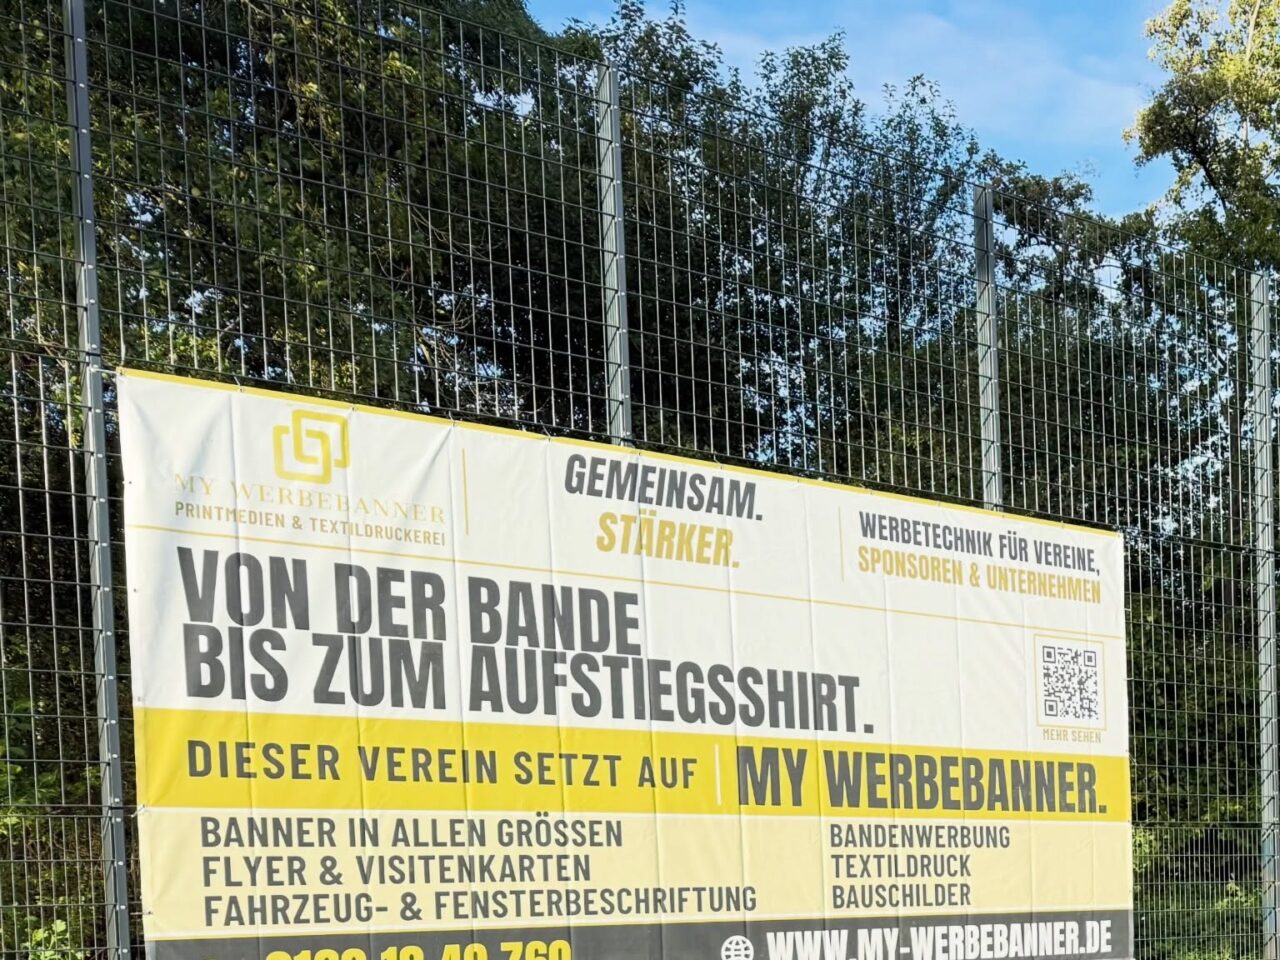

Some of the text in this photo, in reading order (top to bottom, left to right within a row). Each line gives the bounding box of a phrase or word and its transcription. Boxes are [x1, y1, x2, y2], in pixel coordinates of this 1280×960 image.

[175, 473, 446, 524] MY WERBEBANNER
[564, 452, 764, 522] GEMEINSAM.
[175, 502, 446, 546] PRINTMEDIEN & TEXTILDRUCKEREI
[596, 507, 740, 569] STÄRKER.
[859, 511, 1100, 576] WERBETECHNIK FÜR VEREINE,
[858, 546, 1100, 603] SPONSOREN & UNTERNEHMEN
[177, 546, 642, 655] VON DER BANDE
[182, 623, 874, 734] BIS ZUM AUFSTIEGSSHIRT.
[1042, 728, 1101, 743] MEHR SEHEN
[188, 740, 698, 789] DIESER VEREIN SETZT AUF
[736, 745, 1107, 813] MY WERBEBANNER.
[200, 811, 623, 848] BANNER IN ALLEN GRÖSSEN
[830, 824, 1010, 849] BANDENWERBUNG
[202, 855, 591, 887] FLYER & VISITENKARTEN
[831, 854, 971, 878] TEXTILDRUCK
[204, 886, 757, 927] FAHRZEUG- & FENSTERBESCHRIFTUNG
[832, 883, 971, 909] BAUSCHILDER
